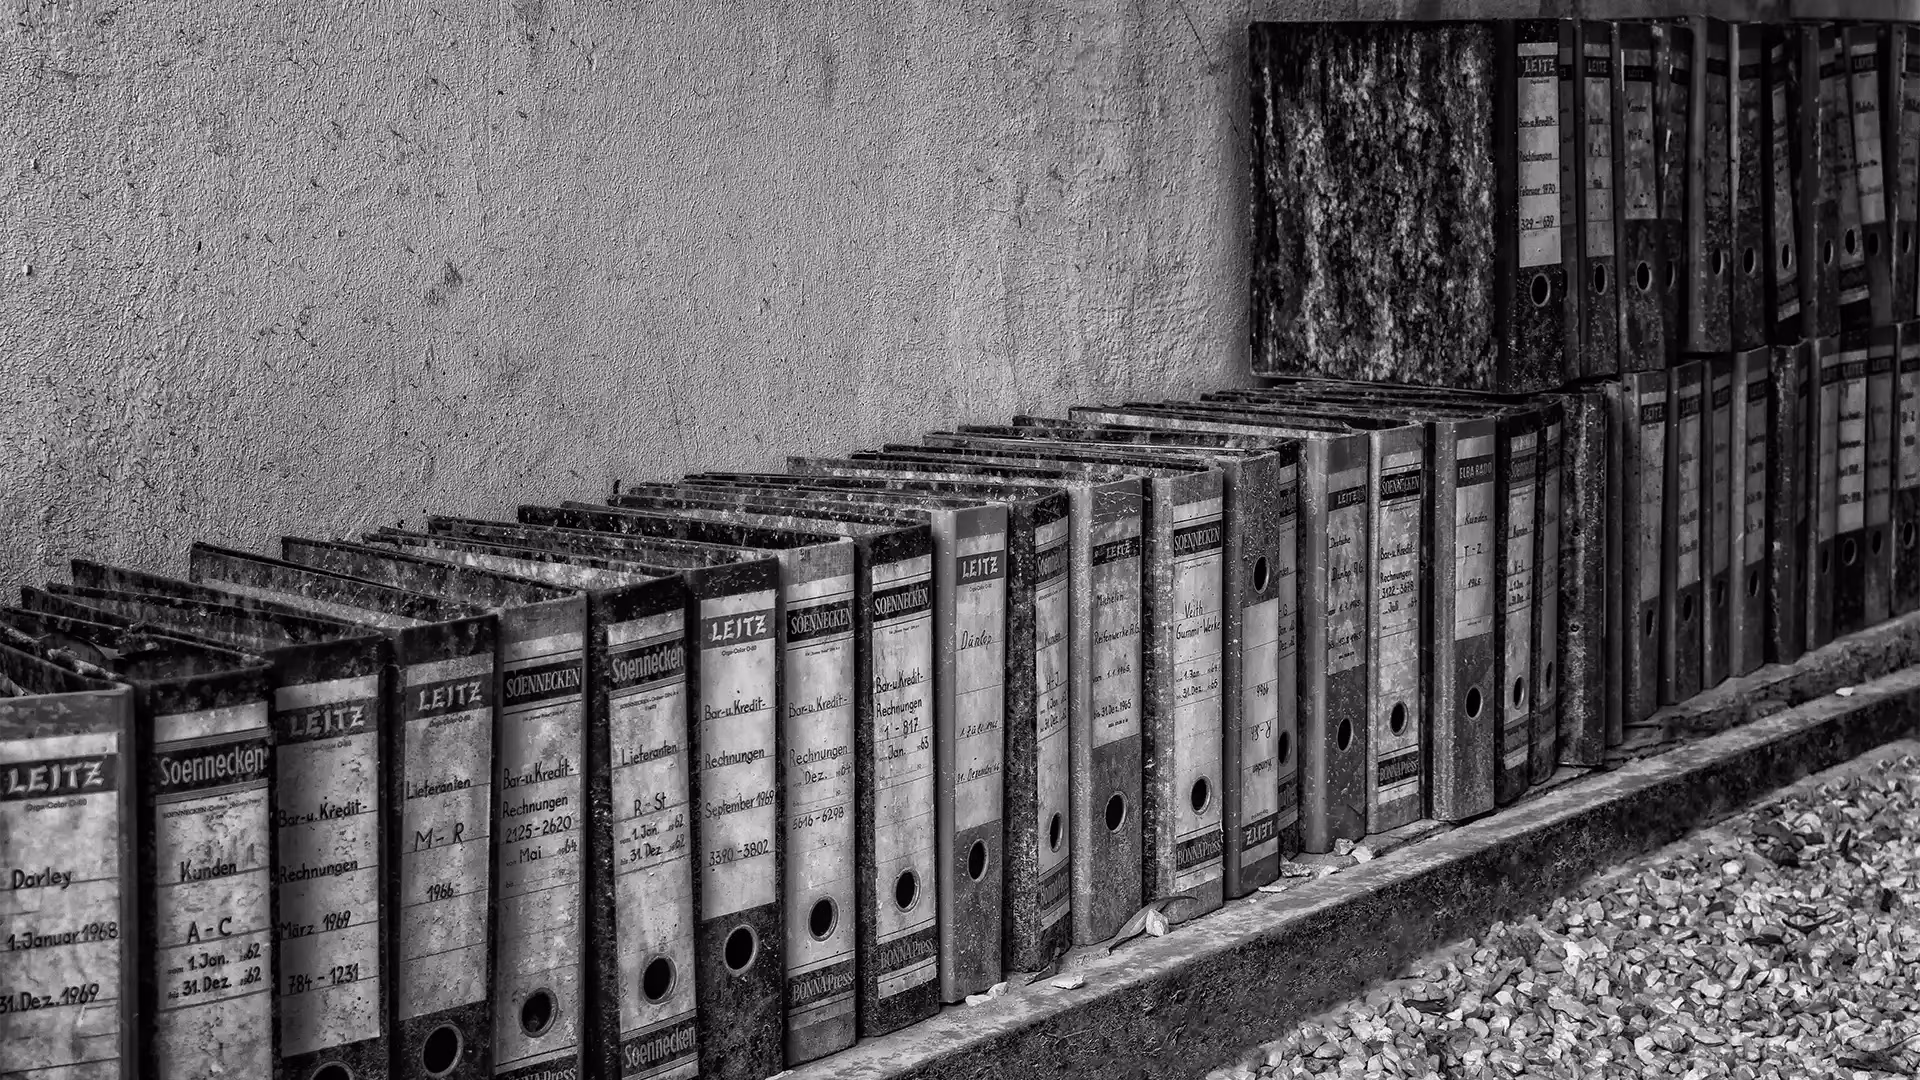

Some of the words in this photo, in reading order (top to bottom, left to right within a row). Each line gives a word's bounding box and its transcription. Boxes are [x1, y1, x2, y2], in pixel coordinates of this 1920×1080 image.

[1524, 59, 1556, 73] LEITZ
[1381, 475, 1420, 496] SOENNECKEN
[1106, 540, 1130, 558] LEITZ
[1174, 526, 1221, 552] SOENNECKEN
[962, 556, 999, 579] LEITZ
[1380, 569, 1413, 585] Rechnungen
[875, 587, 928, 616] SOENNECKEN
[711, 615, 767, 642] LEITZ
[791, 607, 852, 635] SOENNECKEN
[611, 644, 685, 684] Soennecken
[506, 667, 582, 699] SOENNECKEN
[417, 681, 483, 712] LEITZ
[875, 698, 923, 719] Rechnungen
[290, 704, 367, 737] LEITZ
[621, 739, 678, 766] Lieferanten
[705, 748, 765, 769] Rechnungen
[789, 744, 848, 768] Rechnungen
[7, 760, 105, 795] LEITZ
[160, 746, 265, 786] Soennecken
[502, 796, 569, 819] Rechnungen
[705, 795, 755, 819] September
[755, 789, 775, 807] 1969
[519, 846, 542, 864] Mai
[12, 867, 72, 890] Darley
[180, 858, 238, 883] Kunden
[279, 860, 359, 883] Rechnungen
[426, 883, 454, 901] 1966
[279, 922, 315, 939] März
[323, 910, 352, 931] 1969
[288, 974, 313, 994] 784
[330, 963, 359, 985] 1231
[62, 982, 100, 1005] 1969
[625, 1024, 697, 1069] Soennecken
